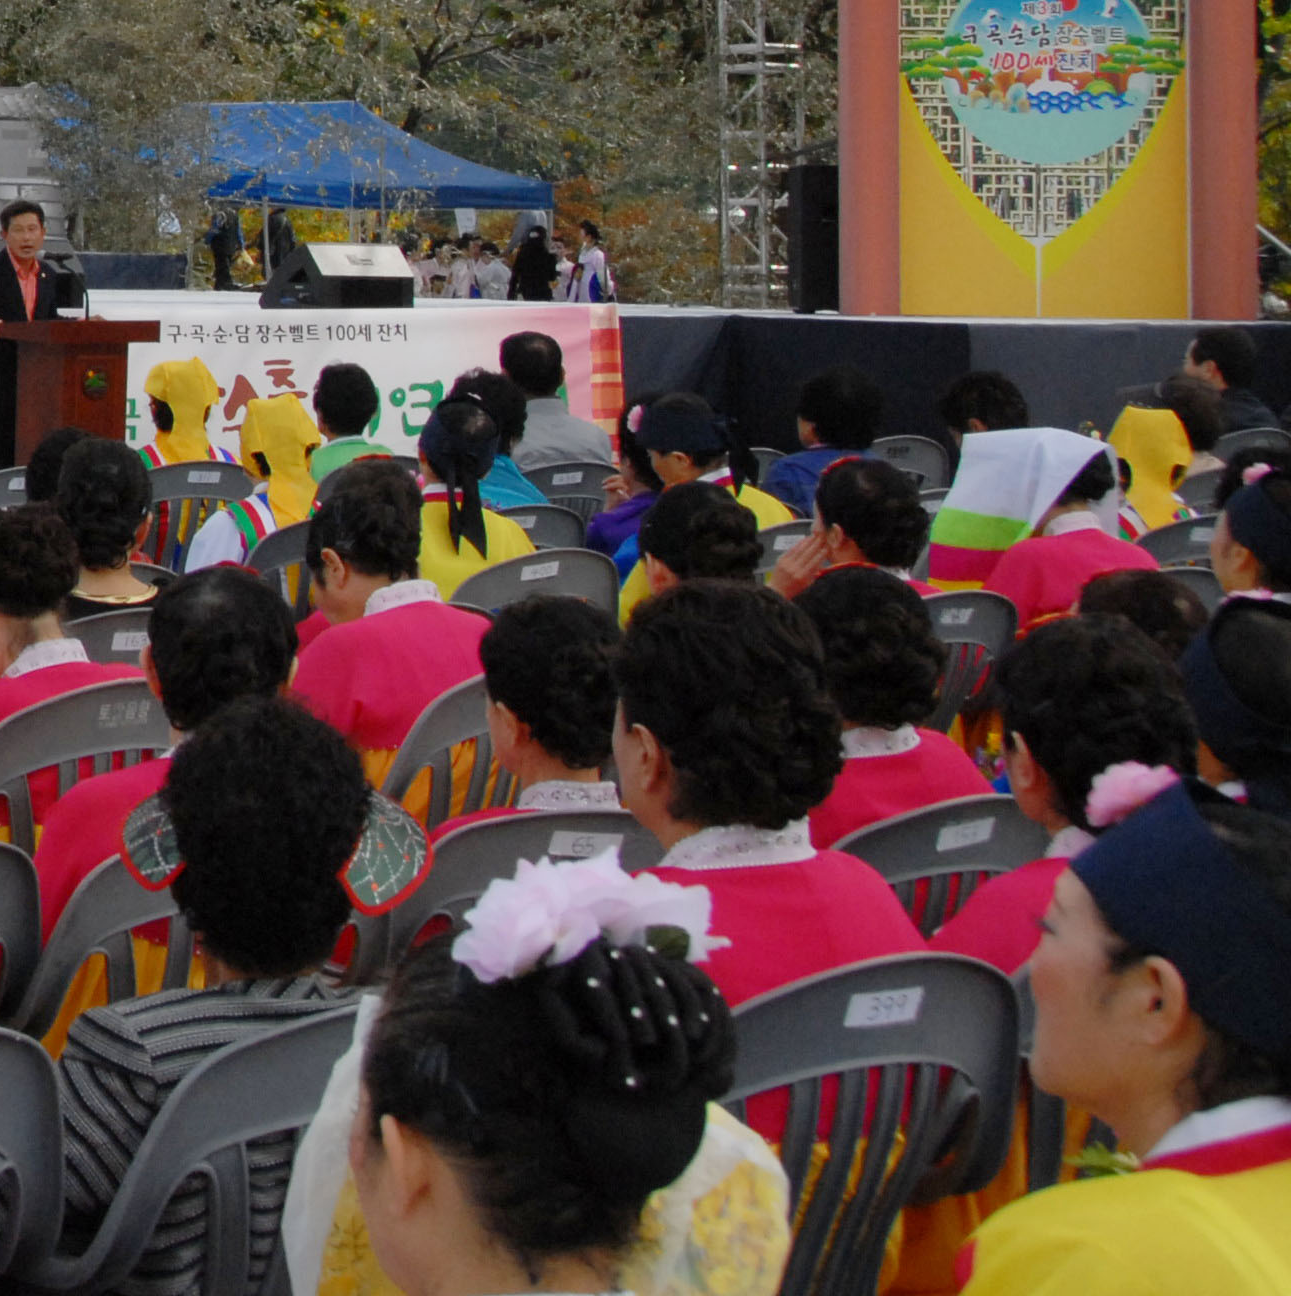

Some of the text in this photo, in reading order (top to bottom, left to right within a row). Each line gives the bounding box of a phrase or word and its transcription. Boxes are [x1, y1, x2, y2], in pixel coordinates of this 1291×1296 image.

[1021, 0, 1062, 15] 제3회
[1055, 25, 1125, 44] 장수벨트
[255, 324, 321, 344] 장수벨트
[325, 323, 373, 343] 100세
[377, 322, 408, 343] 잔치
[572, 835, 596, 856] 65
